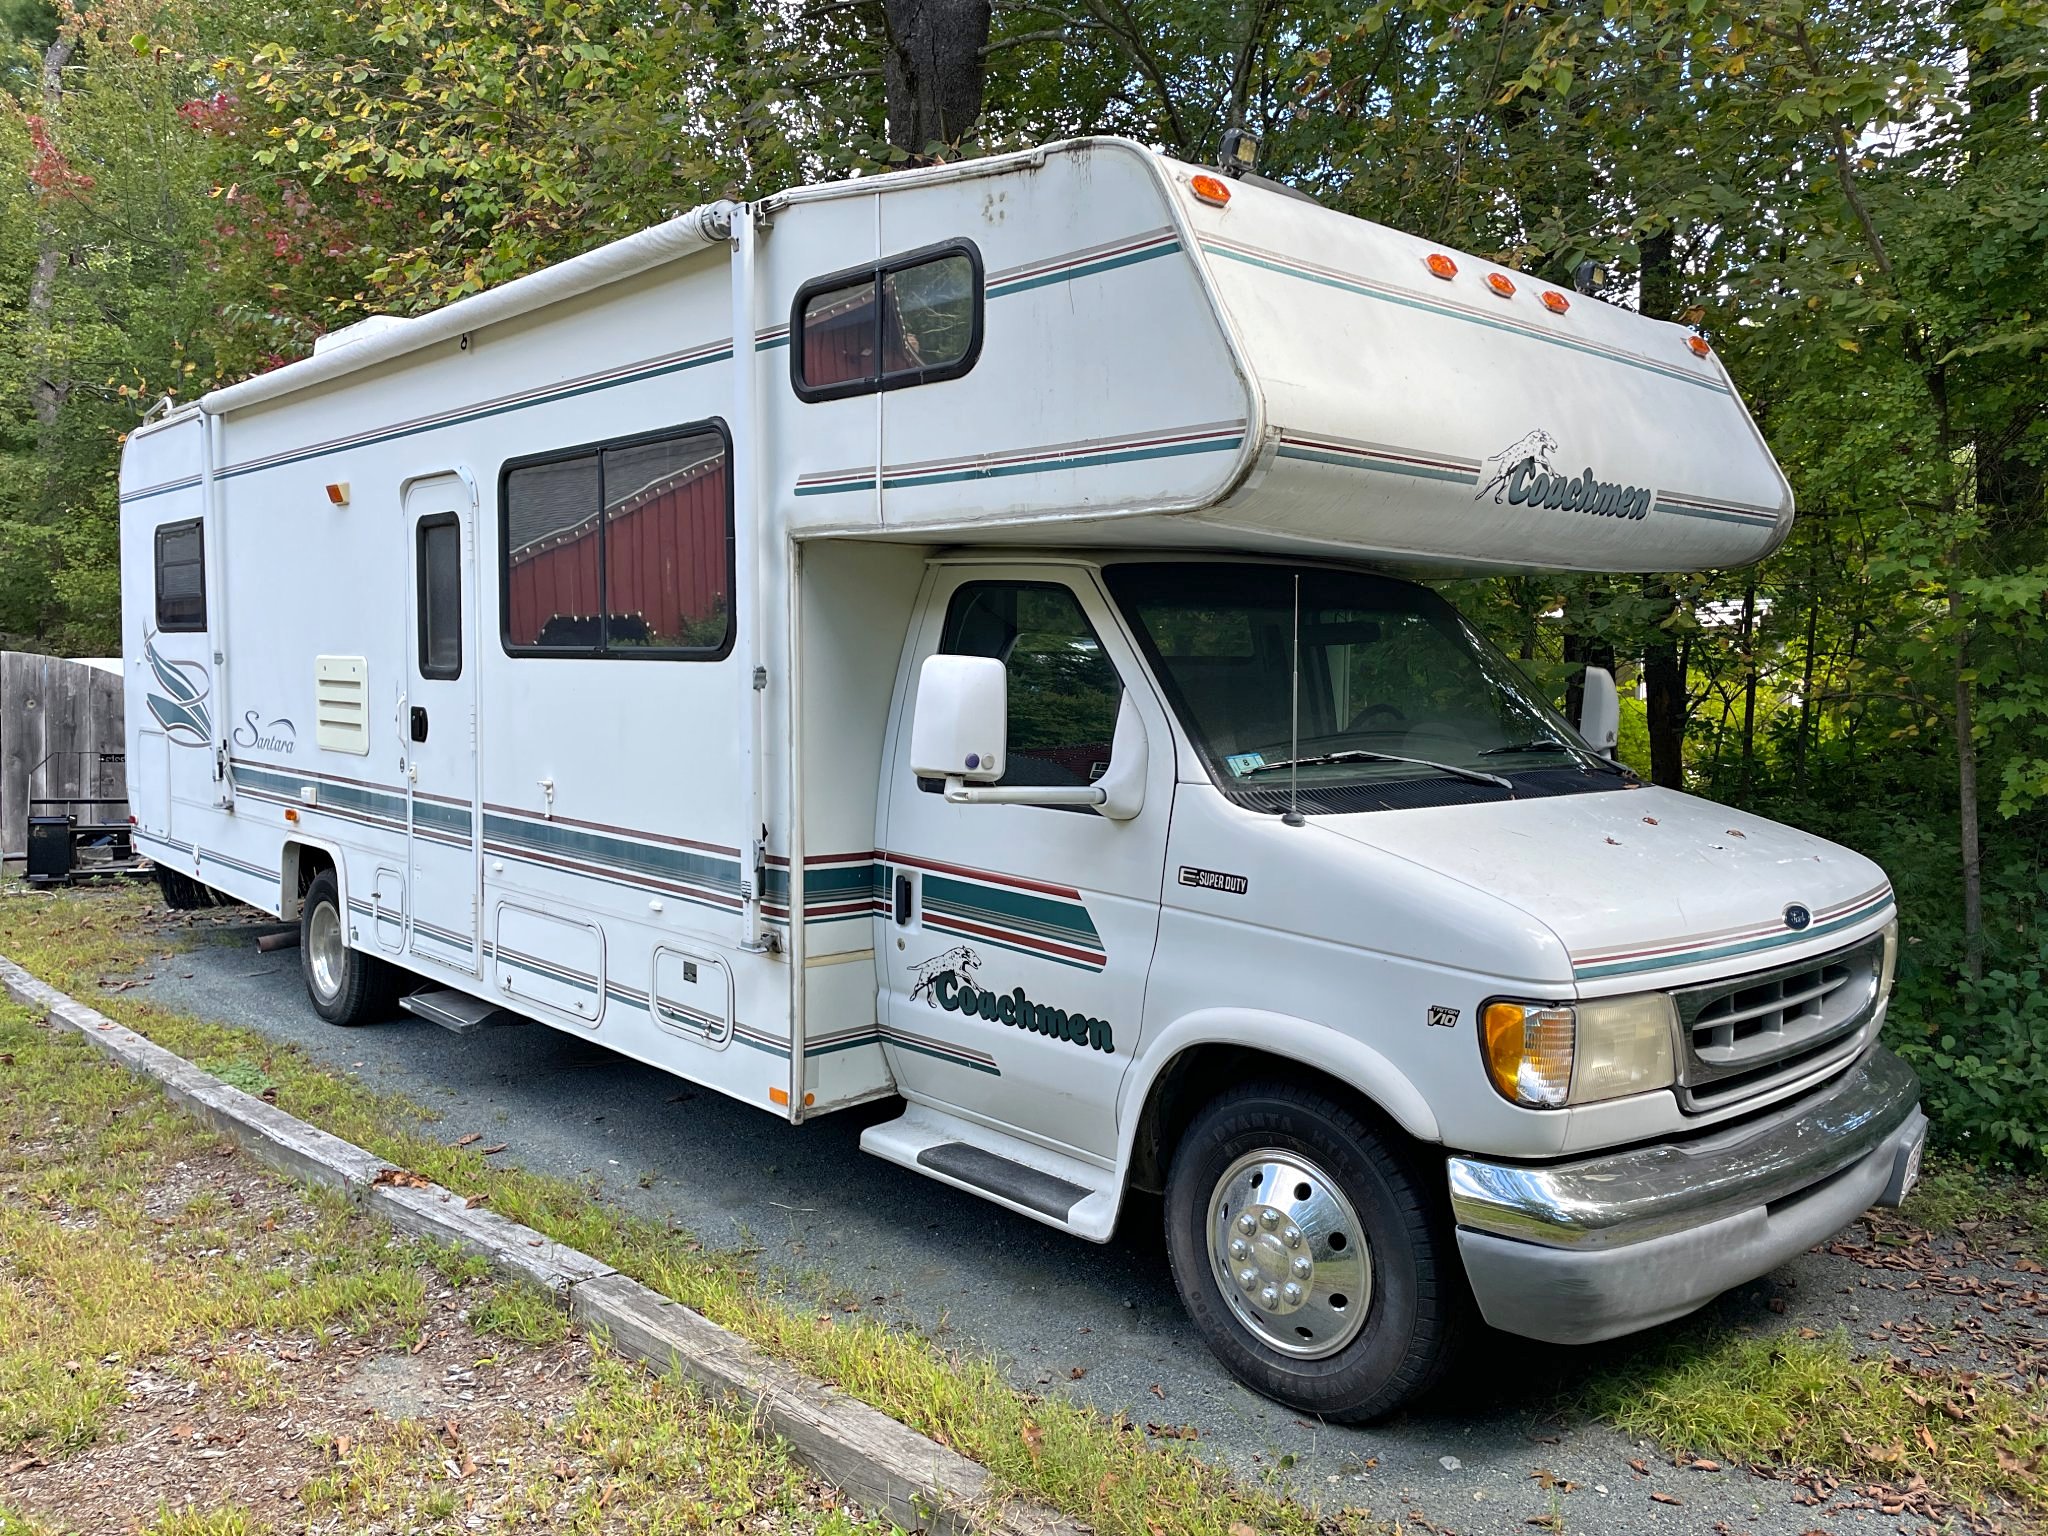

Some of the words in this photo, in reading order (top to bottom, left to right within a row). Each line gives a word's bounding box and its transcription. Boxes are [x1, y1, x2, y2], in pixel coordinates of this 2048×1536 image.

[1508, 457, 1651, 520] Coachmen
[233, 710, 294, 754] Santara
[1225, 876, 1247, 893] DUTY
[935, 970, 1115, 1053] Coachmen
[1428, 1010, 1457, 1027] V10
[1433, 1006, 1459, 1015] TRITON
